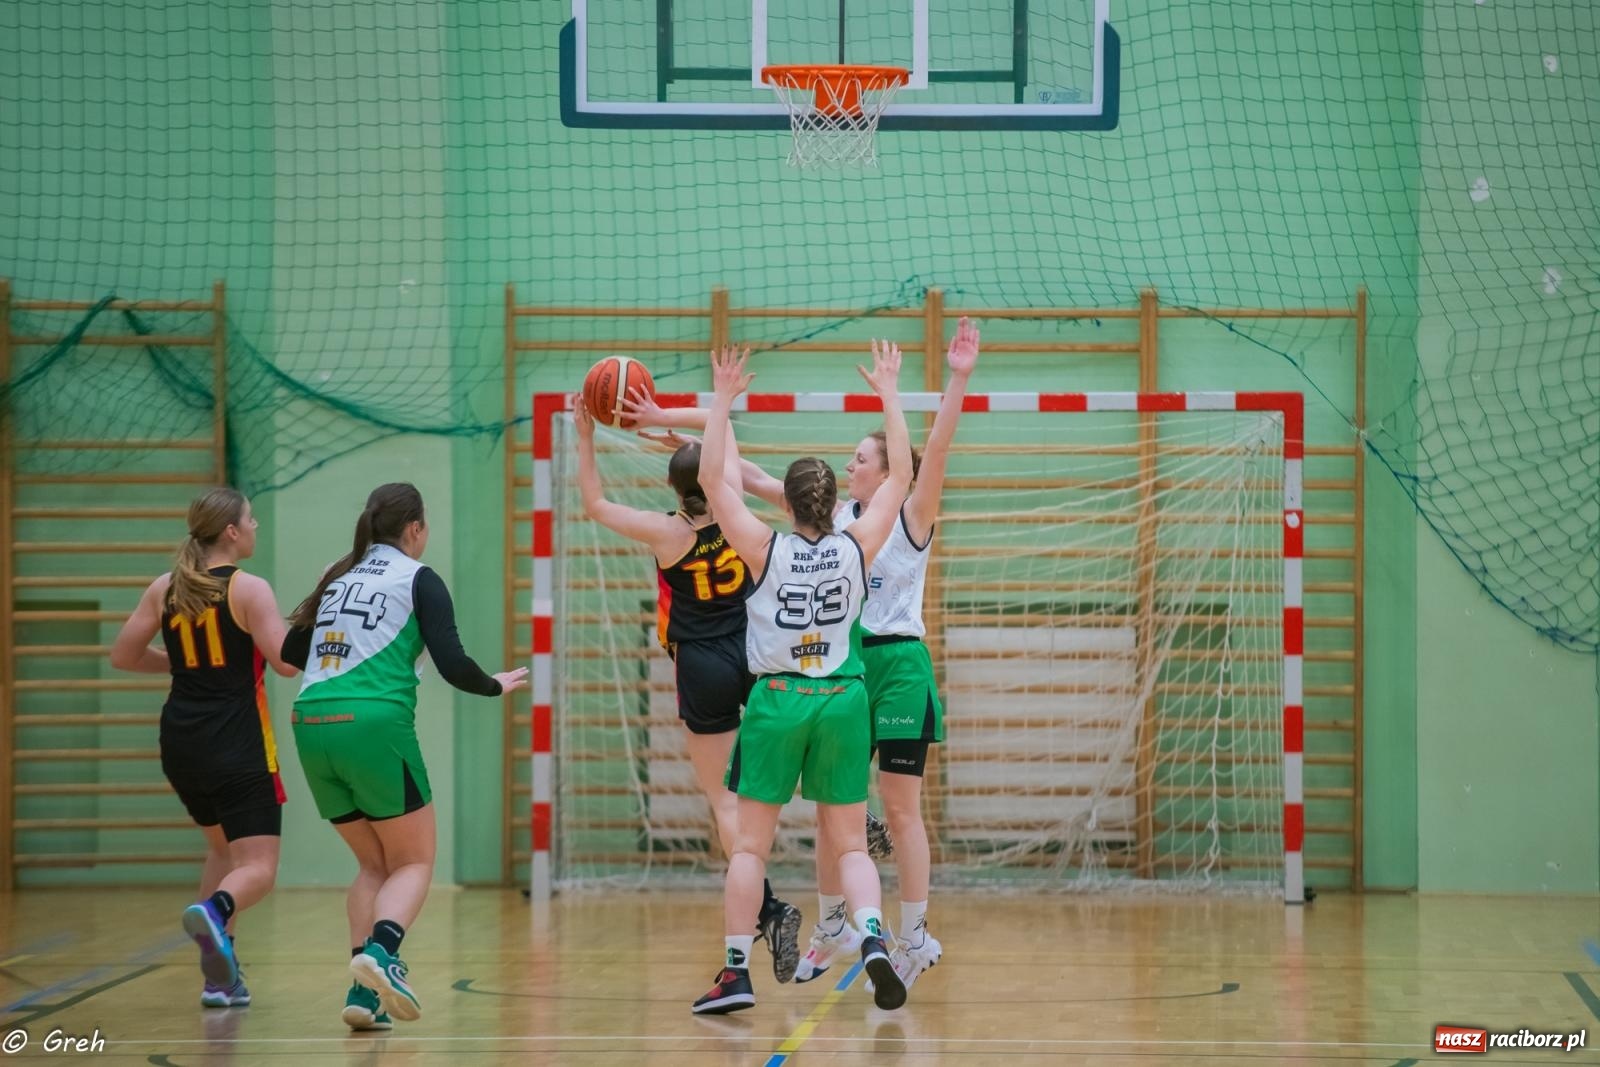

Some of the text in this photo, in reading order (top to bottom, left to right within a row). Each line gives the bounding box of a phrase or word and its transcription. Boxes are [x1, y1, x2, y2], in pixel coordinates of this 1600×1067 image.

[820, 548, 838, 560] AZS
[348, 566, 386, 576] CIBÓRZ
[315, 581, 386, 631] 24
[775, 576, 851, 630] 33
[169, 607, 226, 669] 11
[793, 643, 828, 656] SEGET
